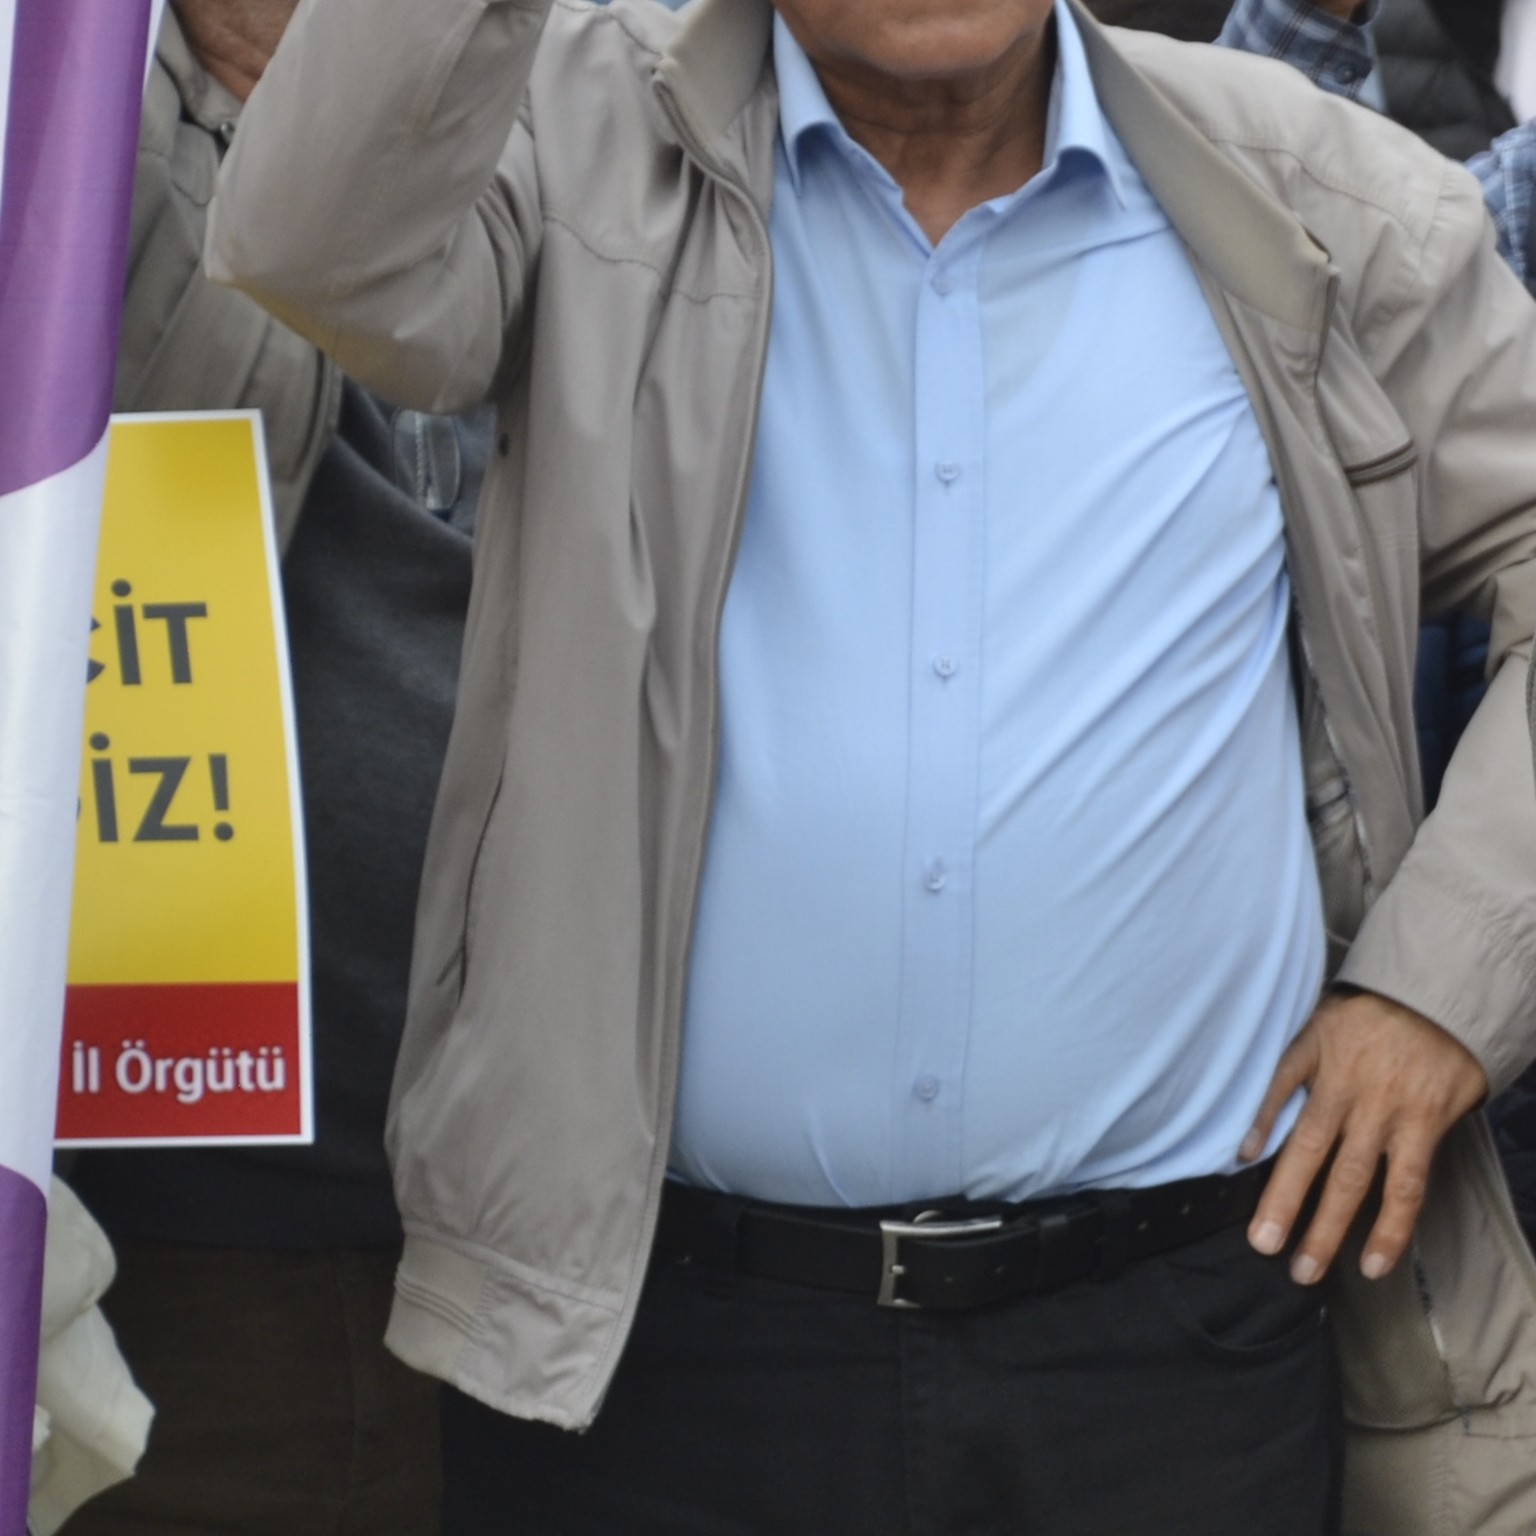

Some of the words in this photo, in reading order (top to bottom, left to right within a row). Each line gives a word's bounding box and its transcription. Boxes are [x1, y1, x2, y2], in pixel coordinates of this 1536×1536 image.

[77, 730, 234, 843] İZ!
[73, 1041, 100, 1093] İl
[116, 1040, 286, 1104] Örgütü
